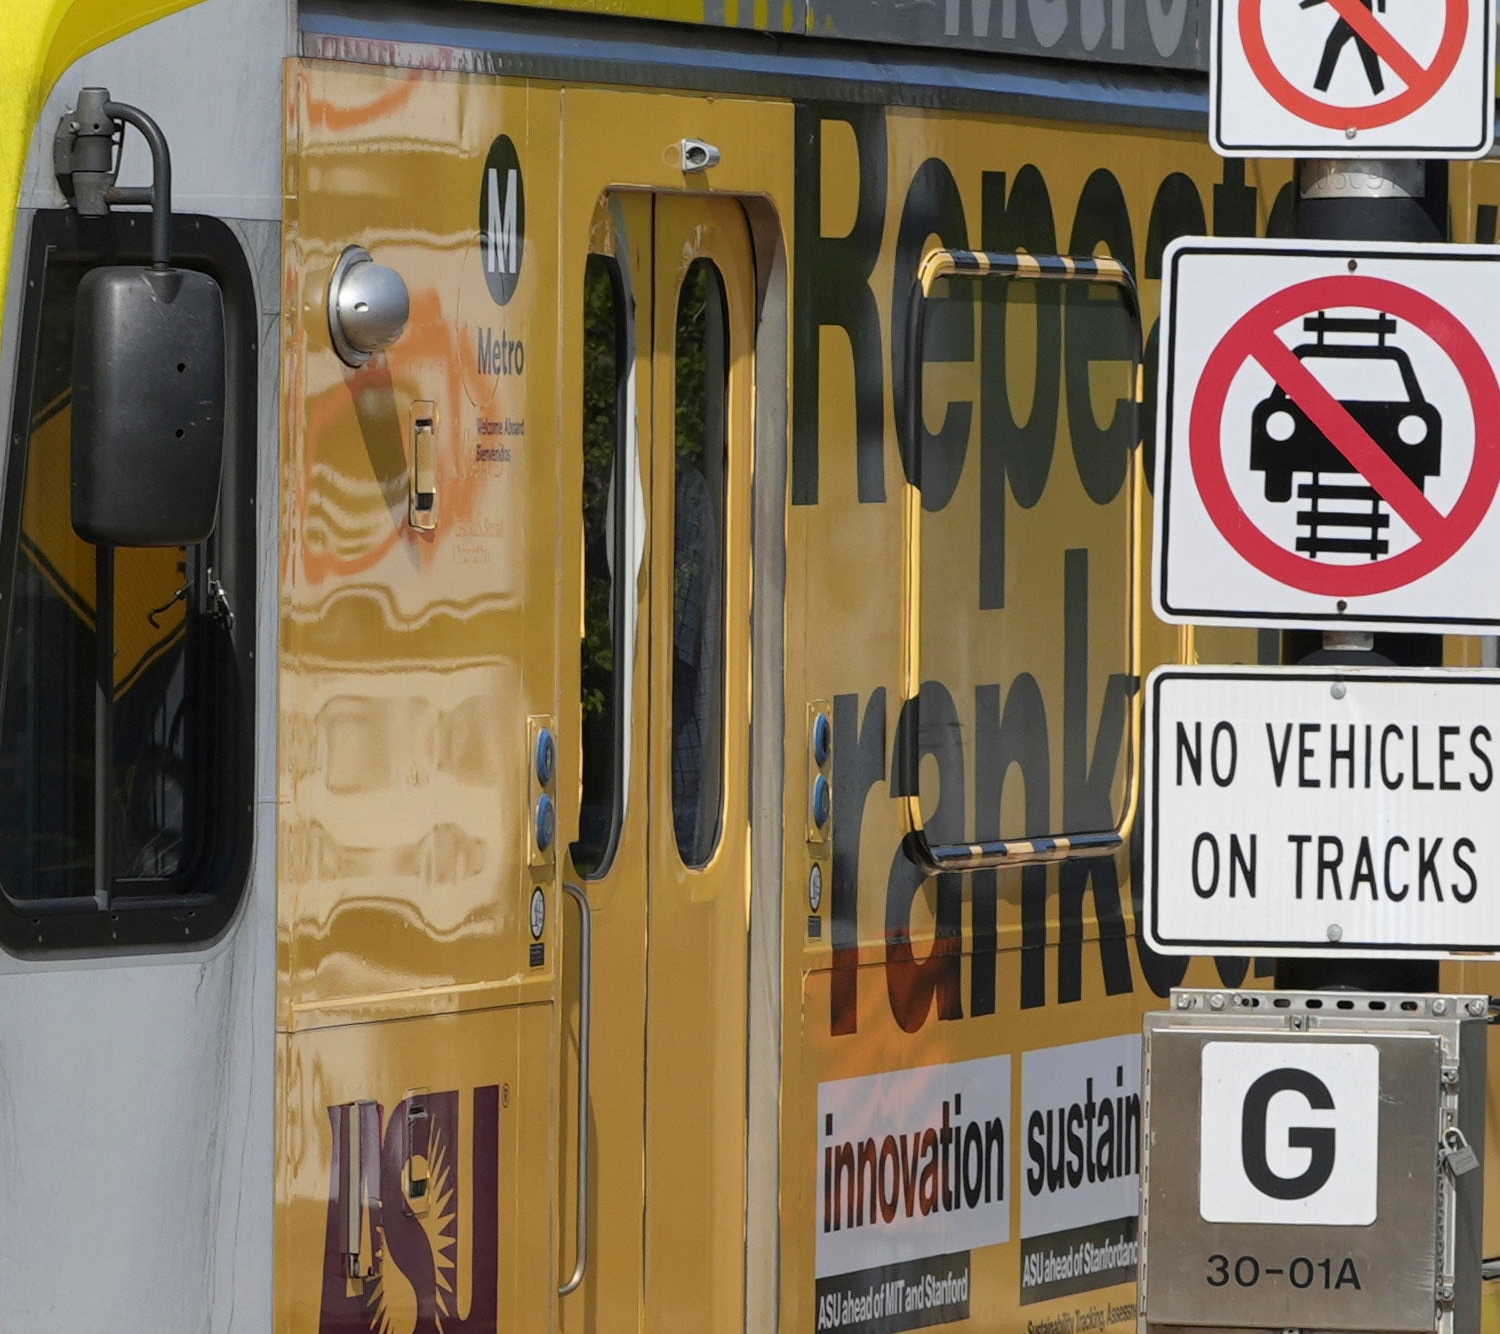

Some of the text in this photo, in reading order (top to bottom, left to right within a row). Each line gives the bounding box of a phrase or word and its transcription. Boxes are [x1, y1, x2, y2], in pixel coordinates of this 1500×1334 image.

[487, 168, 518, 274] M
[477, 326, 525, 377] Metro
[1175, 720, 1495, 793] NO VEHICLES
[1191, 831, 1479, 904] ON TRACKS
[823, 1093, 1005, 1234] innovation
[1240, 1067, 1337, 1201] G
[1022, 1251, 1044, 1287] ASU
[1044, 1245, 1073, 1283] ahead
[1074, 1243, 1084, 1277] of
[1084, 1234, 1124, 1274] Stanford
[1206, 1253, 1362, 1291] 30-01A
[817, 1267, 969, 1330] ASU ahead of MIT and Stanford
